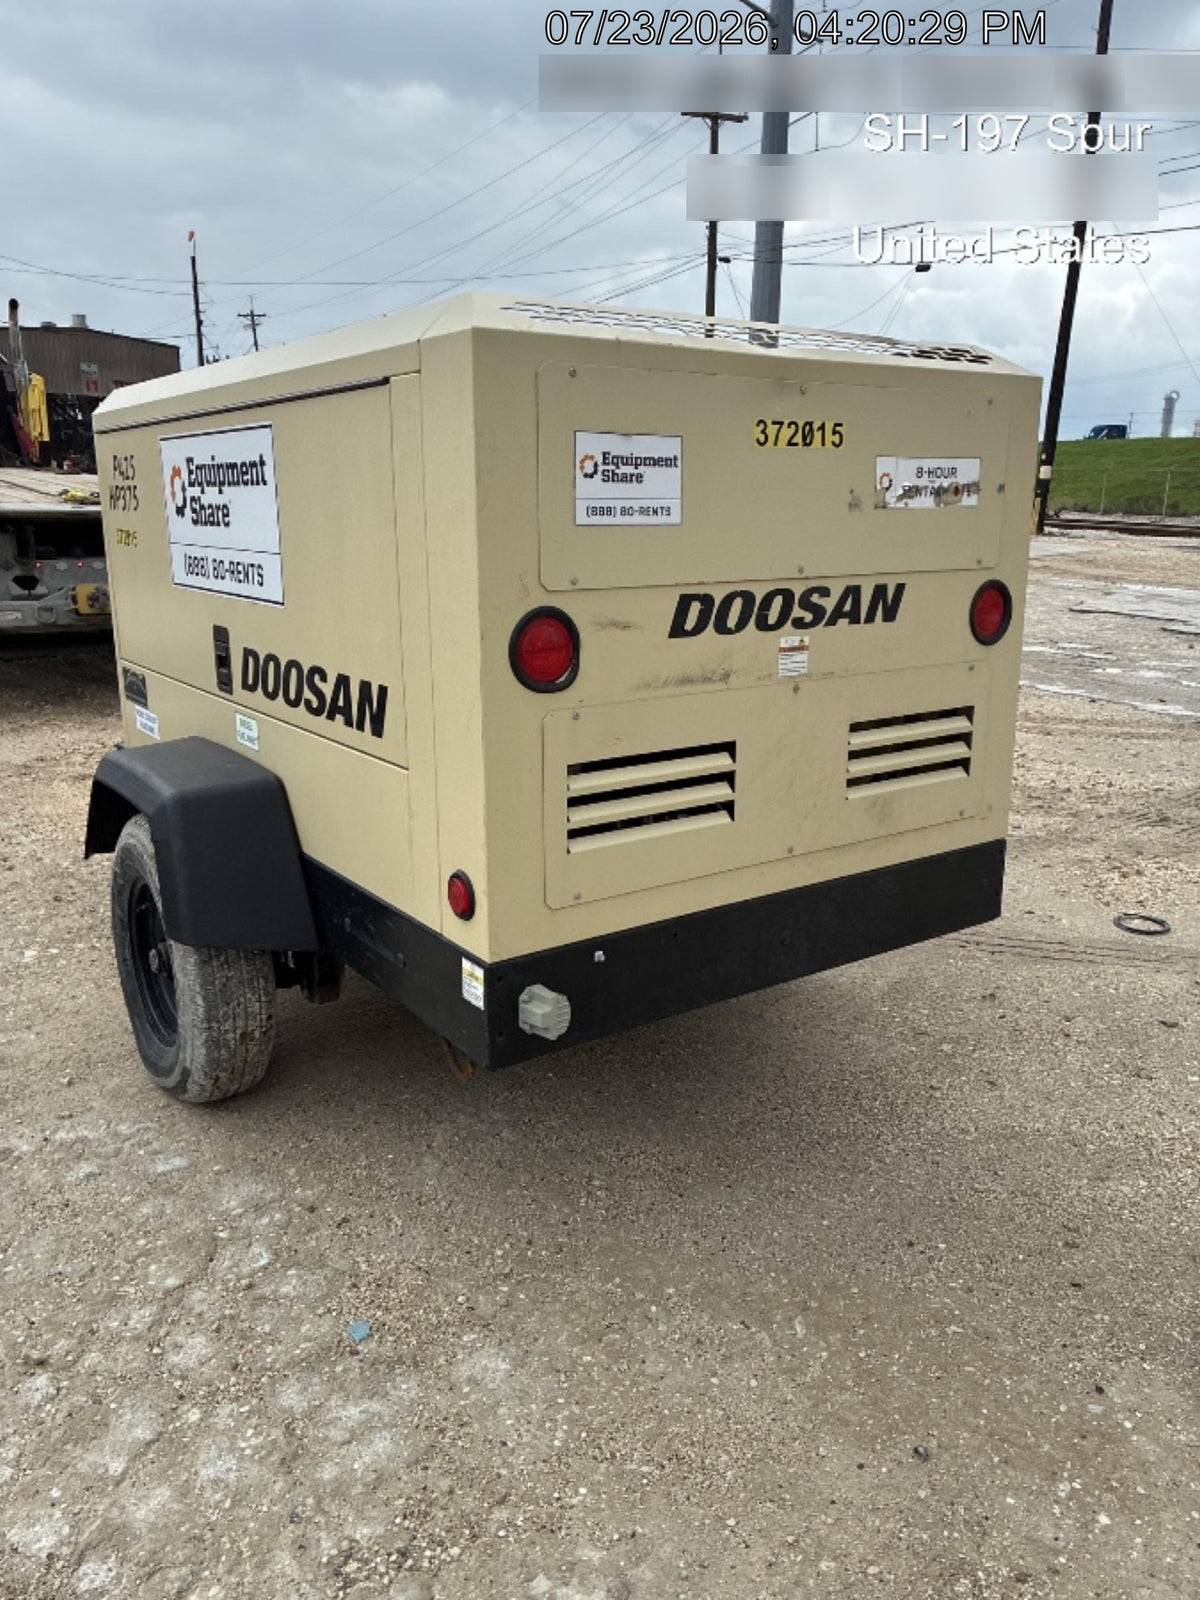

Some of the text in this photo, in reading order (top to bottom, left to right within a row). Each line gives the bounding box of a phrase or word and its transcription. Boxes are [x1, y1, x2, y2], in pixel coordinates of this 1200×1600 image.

[754, 418, 844, 448] 372015
[185, 453, 268, 495] Equipment
[601, 451, 679, 470] Equipment
[601, 469, 644, 484] Share
[189, 496, 230, 528] Share
[586, 506, 671, 518] (888) 80-RENTS
[184, 553, 264, 588] (888) 80-RENTS
[668, 582, 907, 639] DOOSAN
[241, 646, 389, 739] DOOSAN
